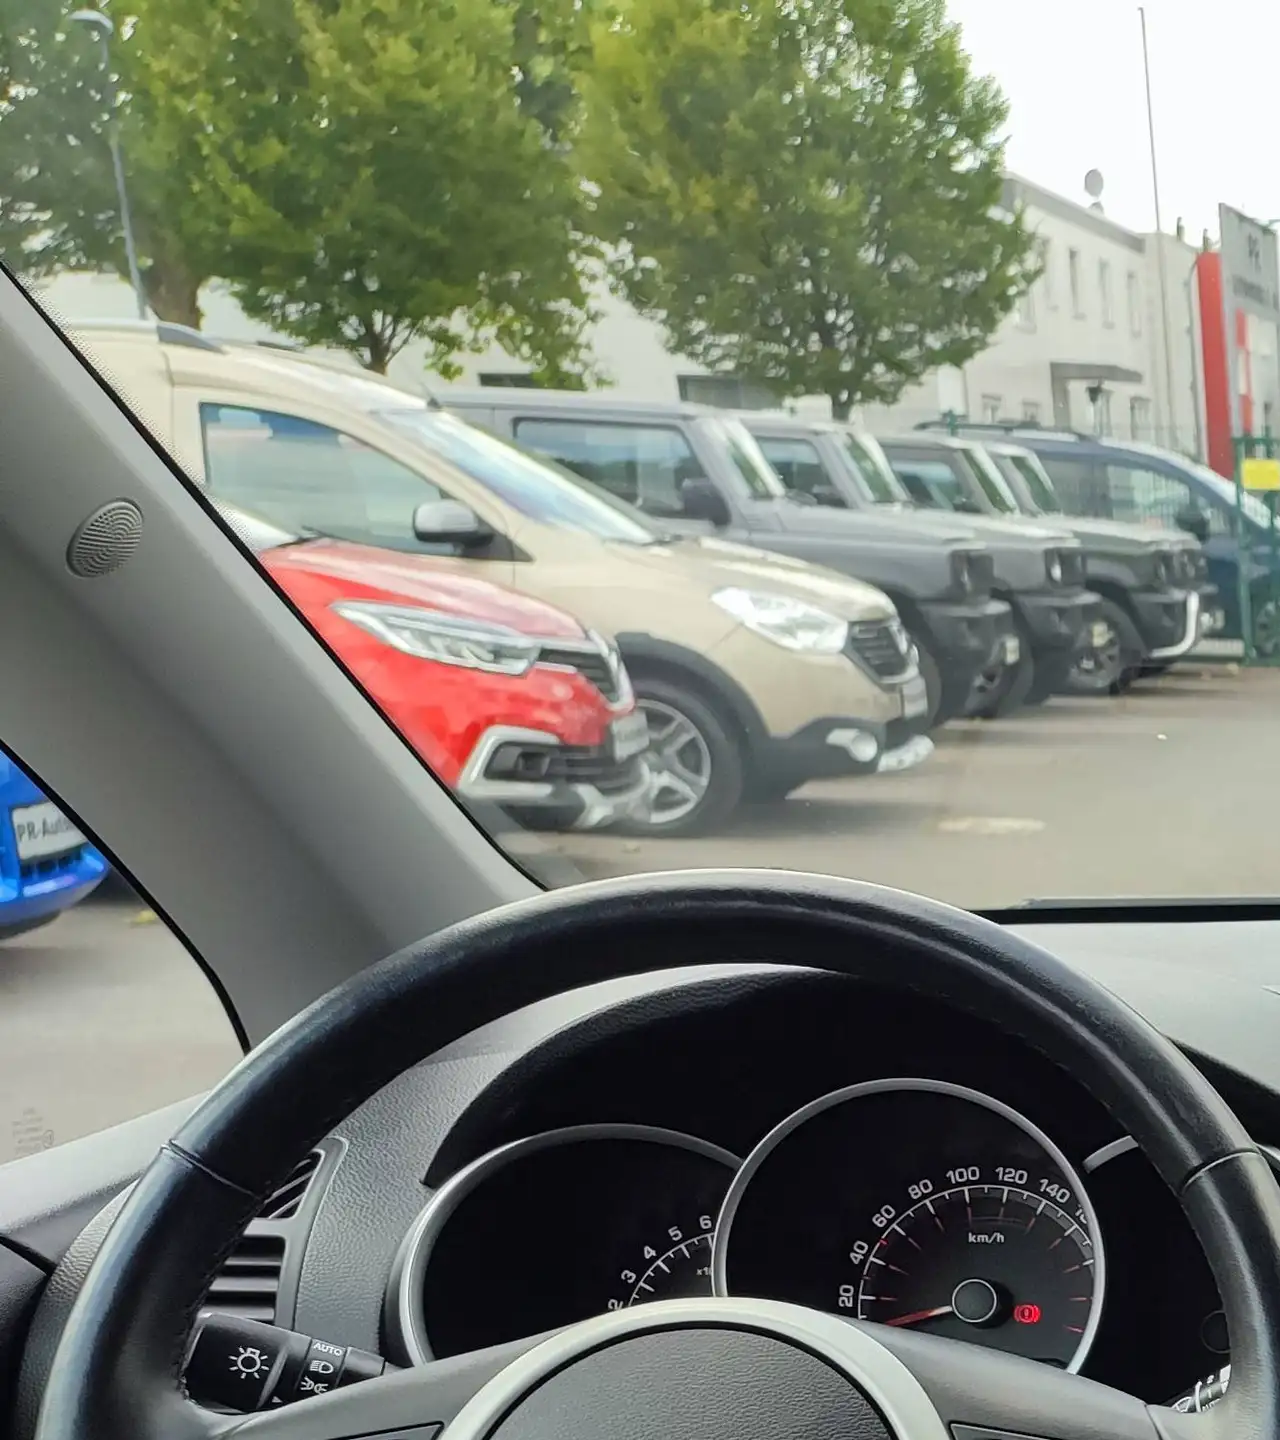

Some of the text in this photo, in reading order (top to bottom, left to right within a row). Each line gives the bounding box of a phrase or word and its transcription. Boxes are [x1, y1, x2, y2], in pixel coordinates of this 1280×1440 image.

[945, 1166, 980, 1184] 100
[996, 1166, 1028, 1185] 120
[908, 1179, 933, 1200] 80
[1039, 1178, 1071, 1204] 140
[699, 1215, 712, 1230] 6
[871, 1204, 896, 1229] 60
[667, 1225, 683, 1242] 5
[968, 1232, 1005, 1244] km/h
[643, 1245, 657, 1260] 4
[849, 1240, 869, 1266] 40
[620, 1269, 637, 1284] 3
[838, 1284, 855, 1307] 20
[313, 1342, 342, 1357] AUTO
